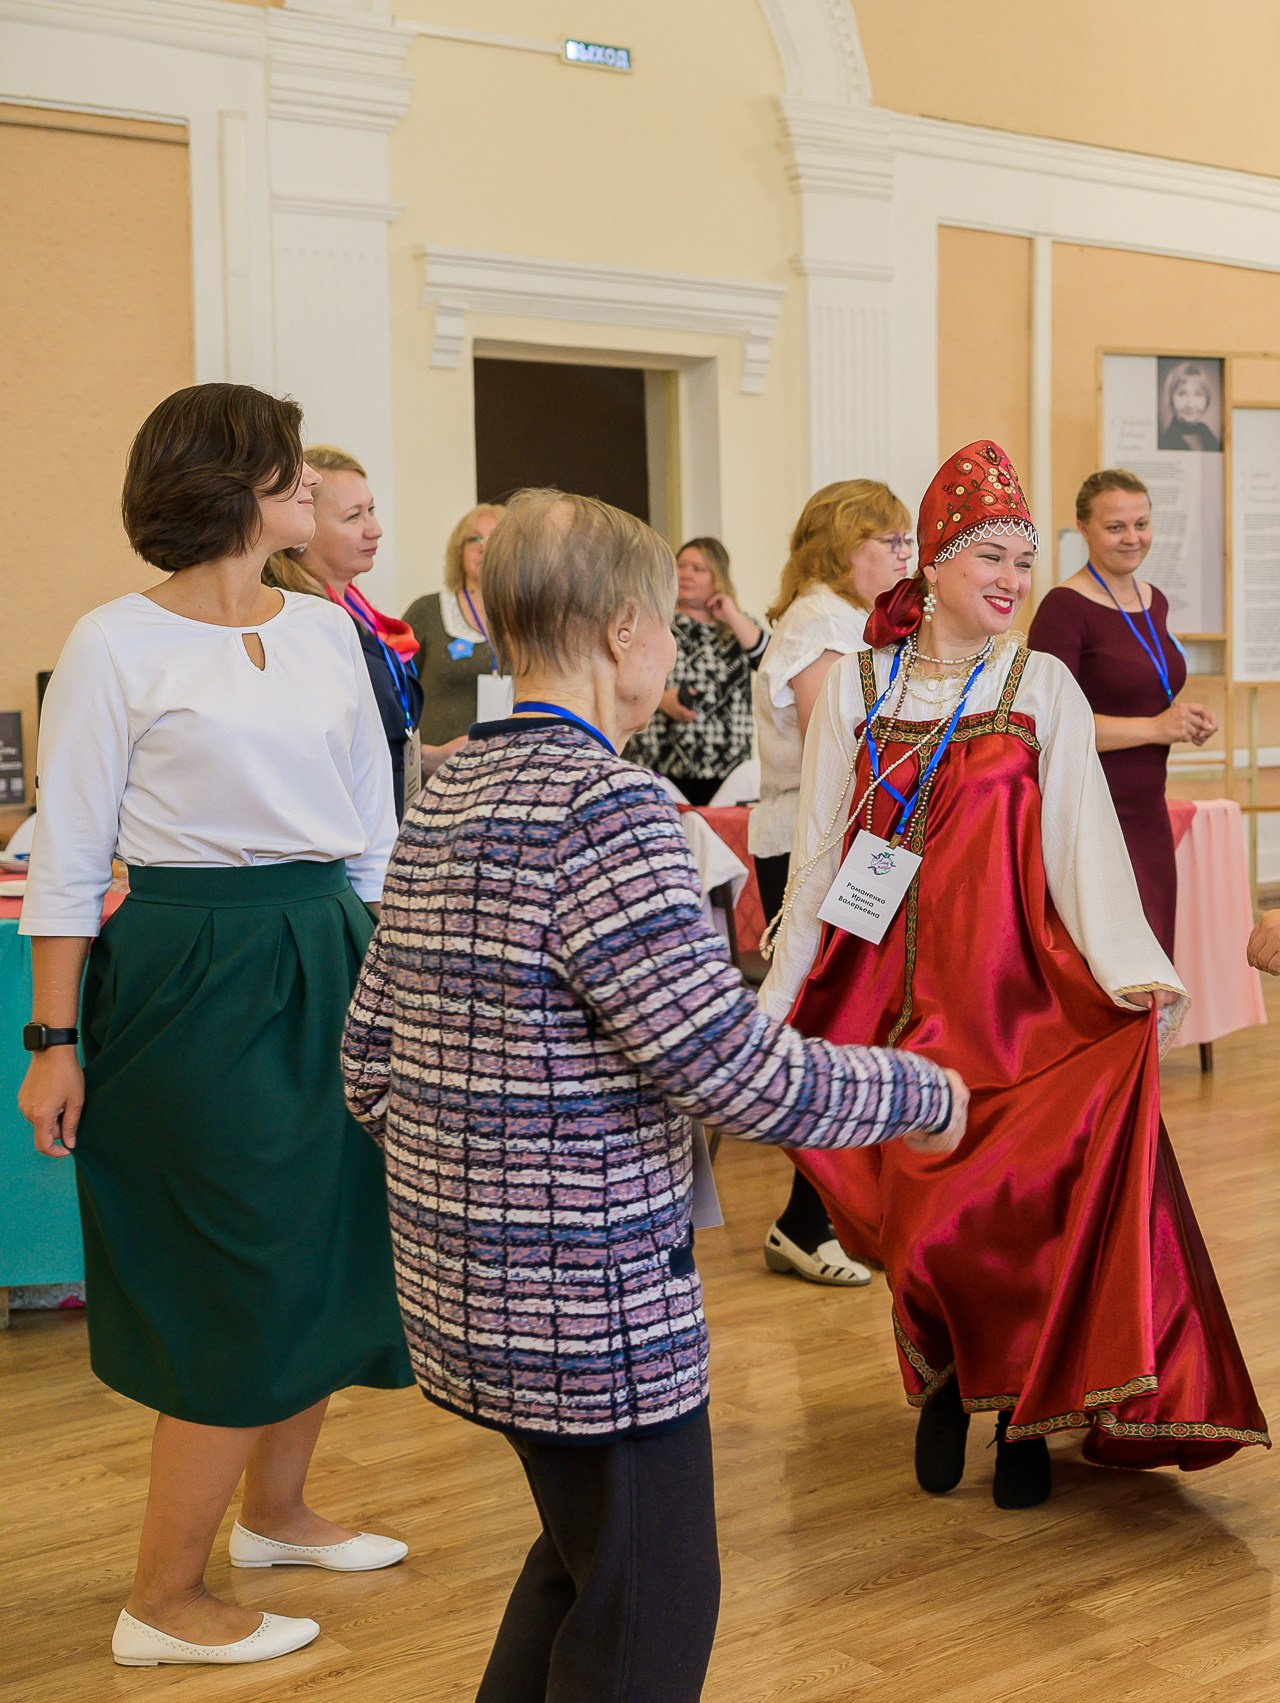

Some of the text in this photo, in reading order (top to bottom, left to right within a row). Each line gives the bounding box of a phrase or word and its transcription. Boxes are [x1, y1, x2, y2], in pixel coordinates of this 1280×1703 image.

[846, 882, 886, 904] Романенко
[851, 893, 874, 907] Ирина
[838, 895, 880, 918] Валерьевна
